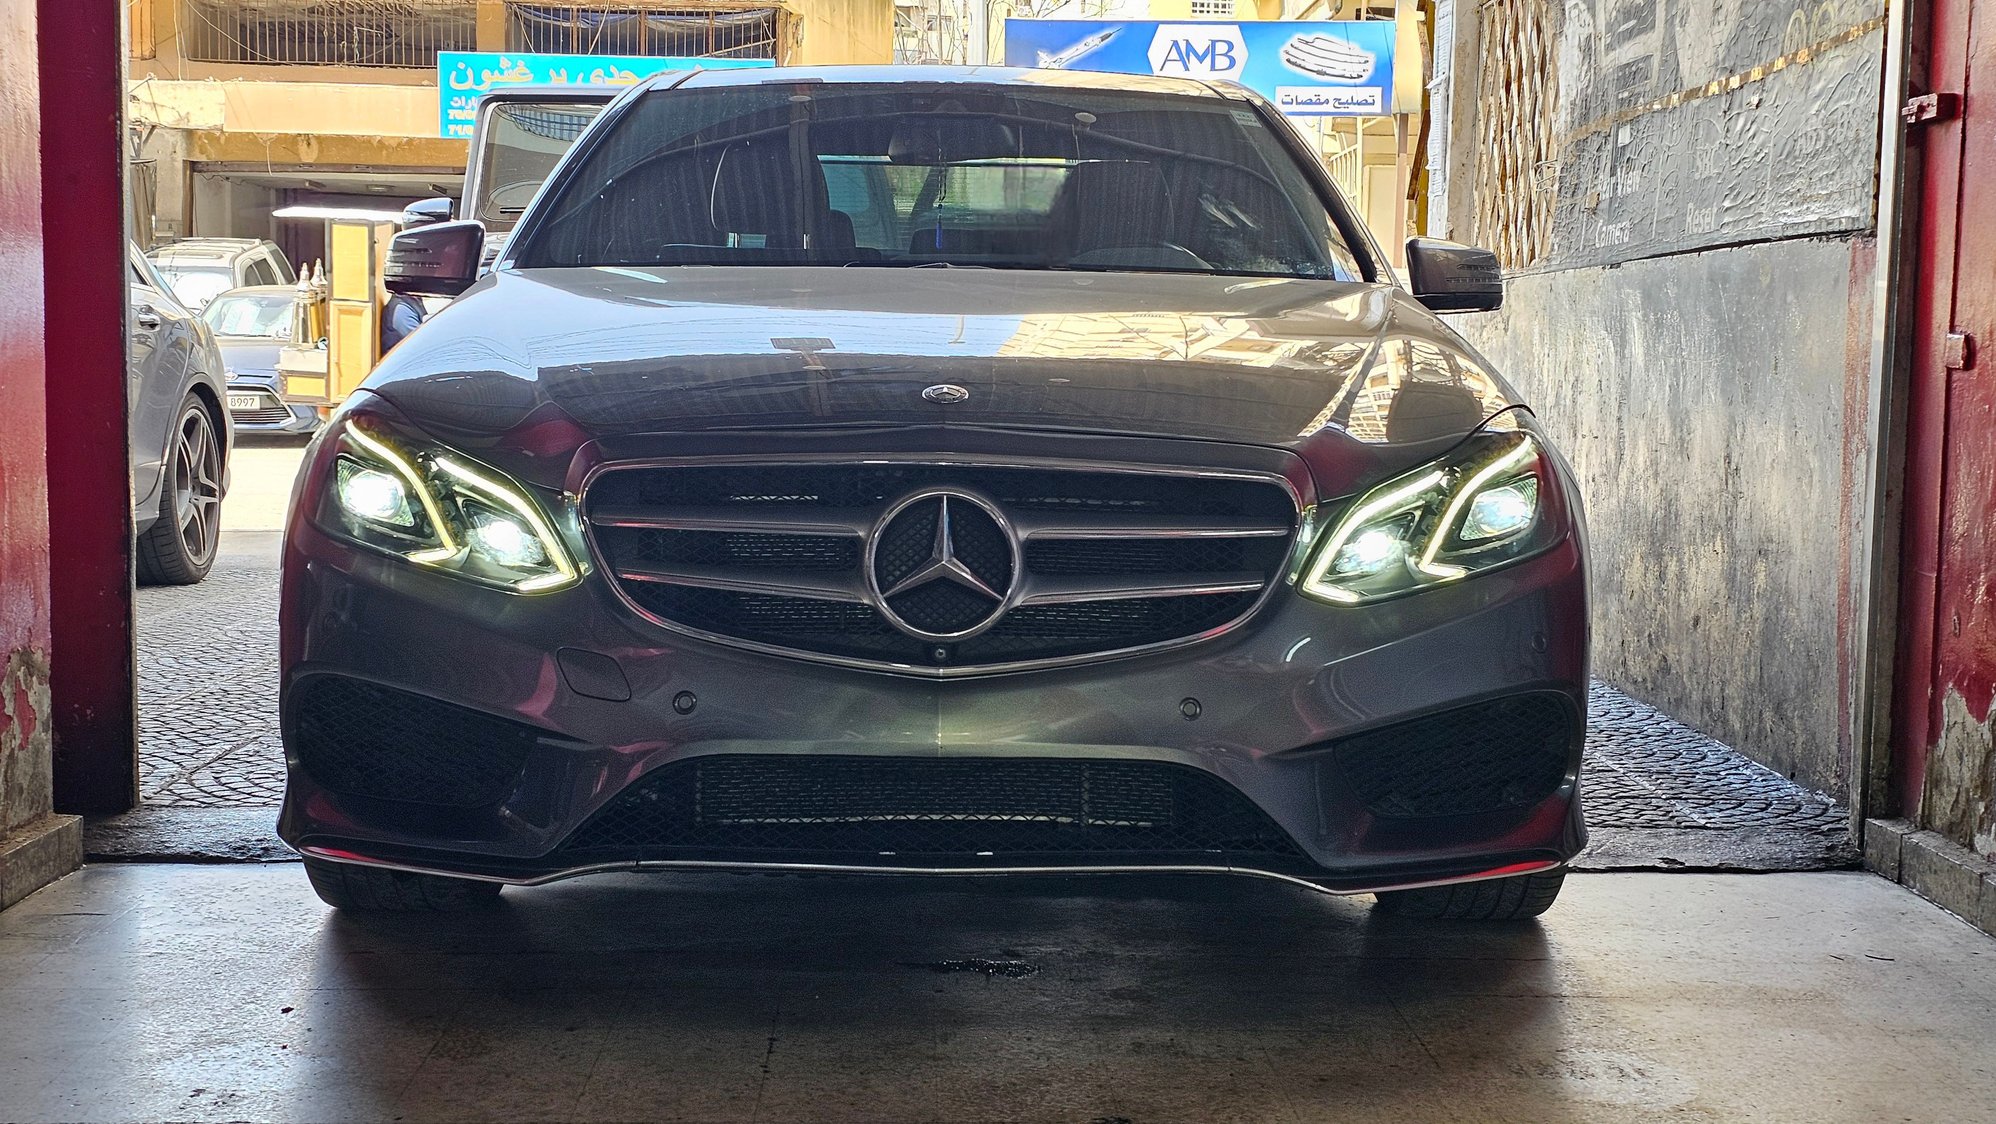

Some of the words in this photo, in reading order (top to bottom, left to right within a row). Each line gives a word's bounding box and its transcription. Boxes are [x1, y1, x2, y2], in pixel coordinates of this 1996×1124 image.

[1159, 38, 1236, 72] AMB
[1281, 94, 1330, 106] مقصات
[1332, 95, 1376, 109] تصليح
[1617, 167, 1641, 198] View
[1685, 202, 1719, 235] Reset
[1594, 219, 1631, 249] Camera
